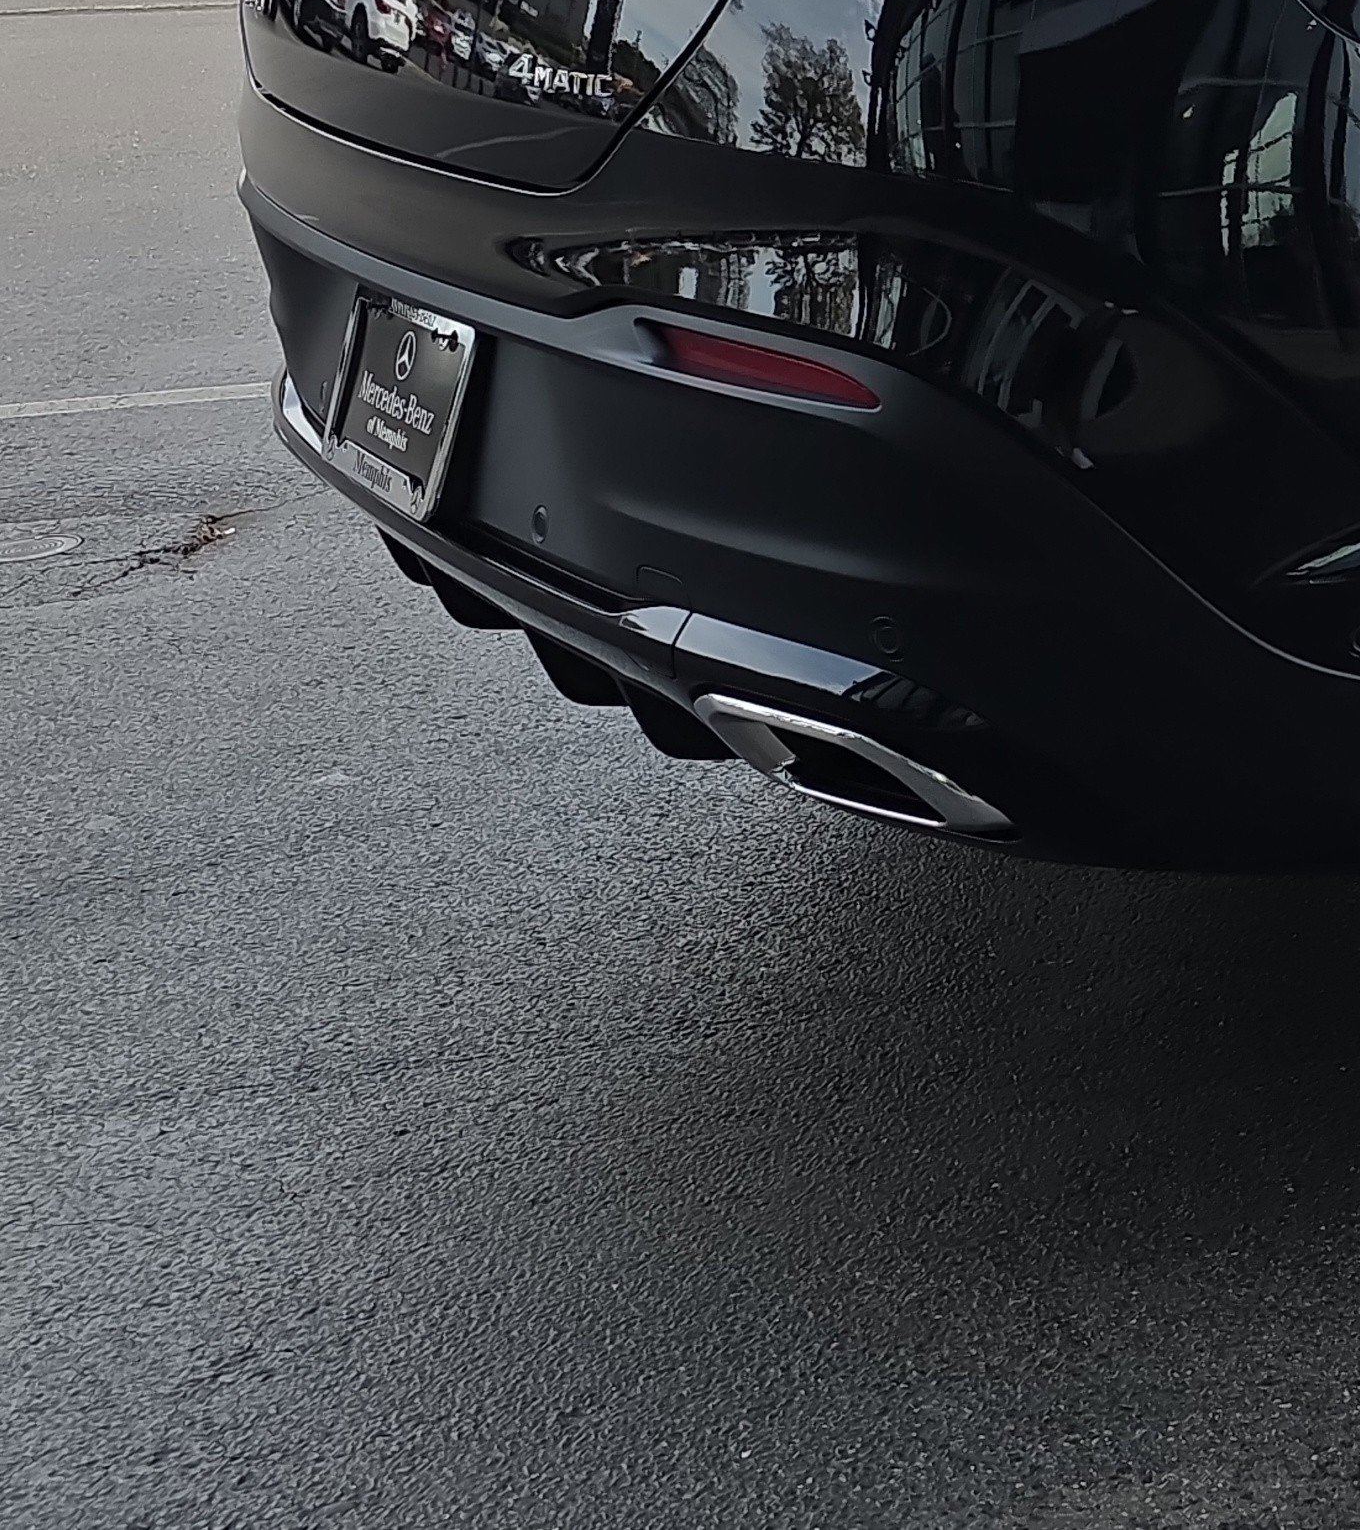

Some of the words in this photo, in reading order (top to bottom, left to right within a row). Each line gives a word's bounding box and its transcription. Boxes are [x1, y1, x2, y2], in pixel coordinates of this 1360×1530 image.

[508, 54, 615, 98] 4MATIC
[357, 370, 435, 435] Mercedes-Benz
[366, 416, 376, 434] of
[374, 419, 408, 453] Memphis
[354, 449, 392, 493] Memphis
